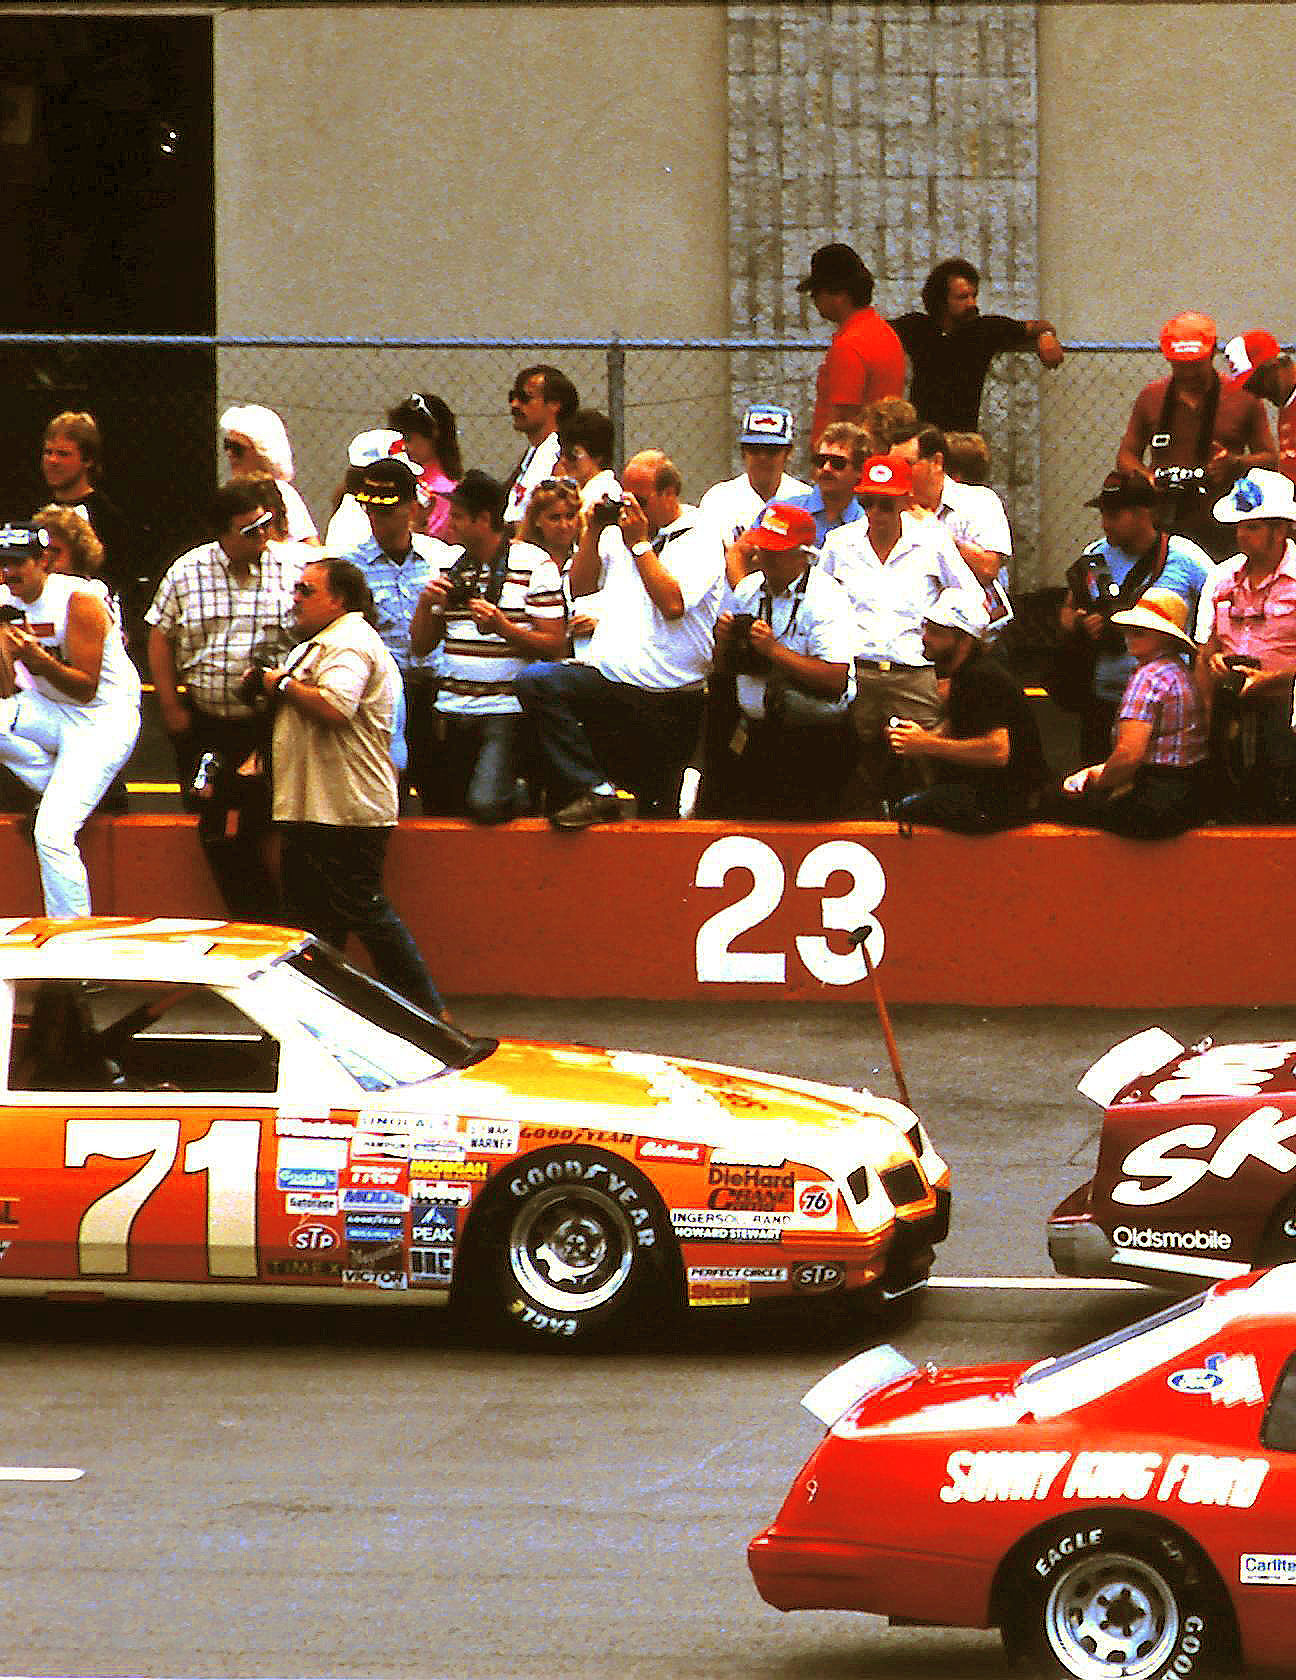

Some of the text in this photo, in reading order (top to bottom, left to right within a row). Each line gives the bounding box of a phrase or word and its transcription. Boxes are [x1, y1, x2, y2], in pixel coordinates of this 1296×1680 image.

[695, 835, 887, 986] 23
[709, 1167, 795, 1187] DieHard
[65, 1119, 261, 1278] 71
[804, 1192, 827, 1210] 76
[295, 1227, 334, 1250] STP
[412, 1227, 454, 1241] PEAK
[1113, 1226, 1232, 1250] Oldsmobile
[800, 1264, 838, 1285] STP
[940, 1450, 1072, 1503] SUNNY
[1035, 1528, 1103, 1576] EAGLE
[1246, 1557, 1296, 1572] Carlite
